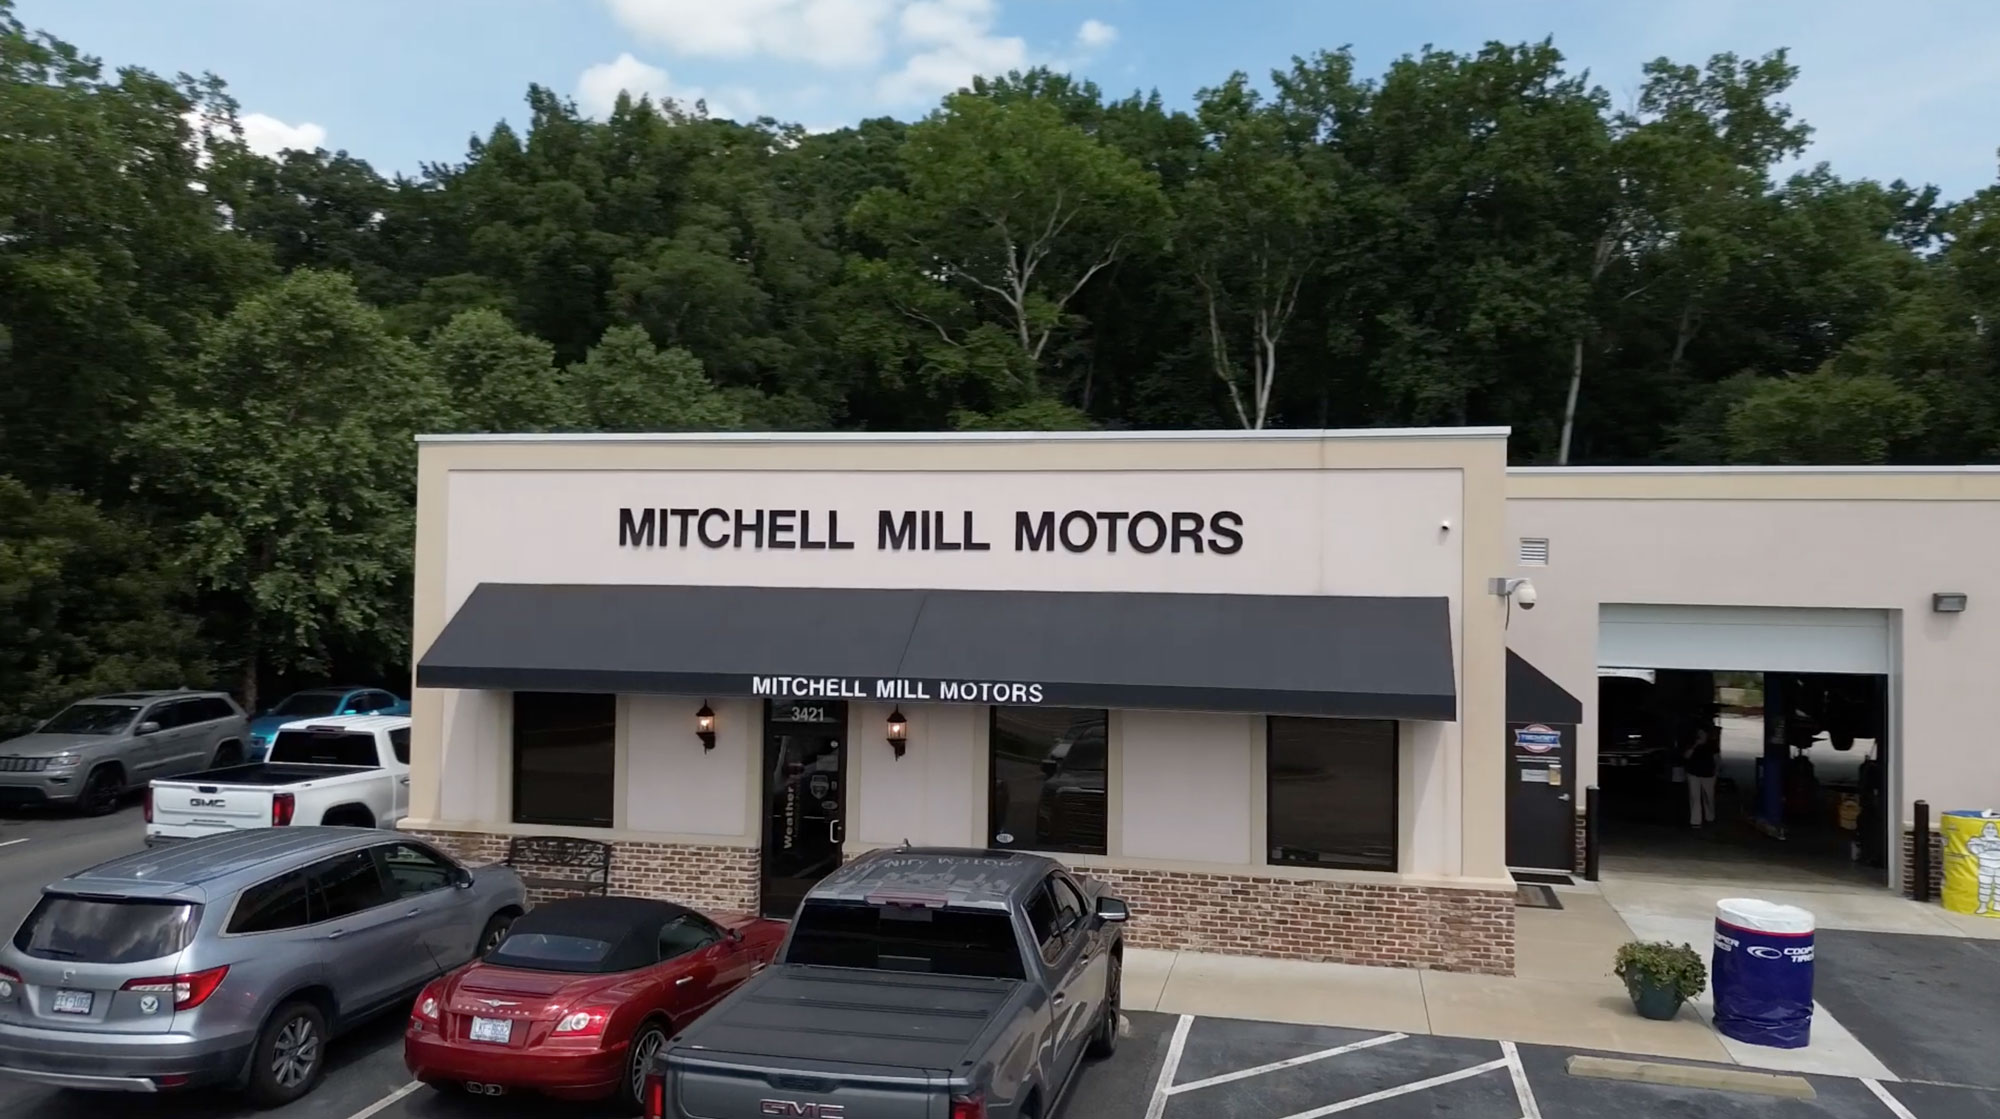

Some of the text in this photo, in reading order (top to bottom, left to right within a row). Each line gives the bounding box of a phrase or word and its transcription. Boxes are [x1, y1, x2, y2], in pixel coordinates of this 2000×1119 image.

[619, 508, 1244, 554] MITCHELL MILL MOTORS
[752, 676, 1043, 702] MITCHELL MILL MOTORS
[791, 707, 824, 722] 3421
[190, 798, 226, 807] GMC
[783, 786, 795, 849] Weather
[760, 1099, 845, 1119] GMC
